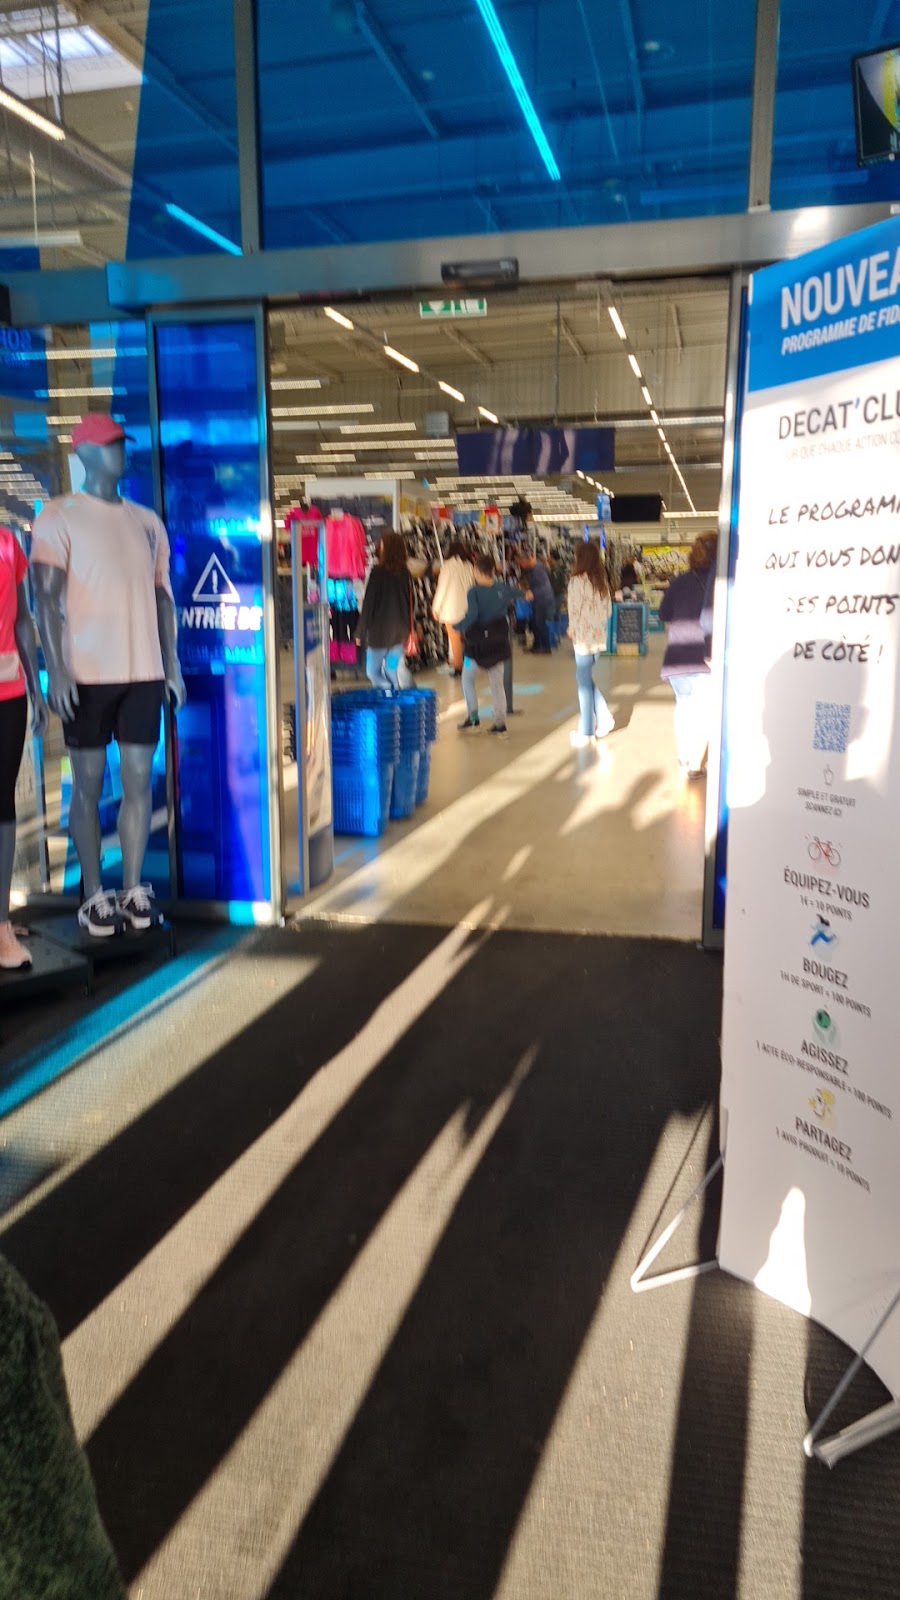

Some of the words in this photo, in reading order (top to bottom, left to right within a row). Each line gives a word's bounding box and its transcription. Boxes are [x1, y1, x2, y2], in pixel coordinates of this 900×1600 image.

[781, 316, 858, 356] PROGRAMME
[857, 310, 878, 335] DE
[768, 506, 791, 525] LE
[797, 494, 900, 522] PROGRAM
[765, 550, 800, 570] QUI
[806, 546, 855, 568] VOUS
[825, 593, 900, 615] POINTS
[793, 640, 816, 660] DE
[797, 787, 819, 800] SIMPLE
[820, 792, 829, 801] ET
[829, 794, 856, 808] GRATUIT
[805, 801, 833, 815] SCANNEZ
[783, 865, 870, 908] ÉQUIPEZ-VOUS
[815, 899, 825, 910] 10
[826, 903, 853, 920] POINTS
[803, 957, 848, 990] BOUGEZ
[790, 974, 800, 985] DE
[801, 978, 824, 996] SPORT
[831, 991, 845, 1005] 100
[845, 996, 872, 1018] POINTS
[801, 1039, 848, 1077] AGISSEZ
[762, 1042, 779, 1058] ACTE
[866, 1095, 892, 1120] POINTS
[795, 1116, 852, 1164] PARTAGEZ
[781, 1130, 798, 1146] AVIS
[798, 1139, 829, 1165] PRODUIT
[845, 1167, 871, 1193] POINTS
